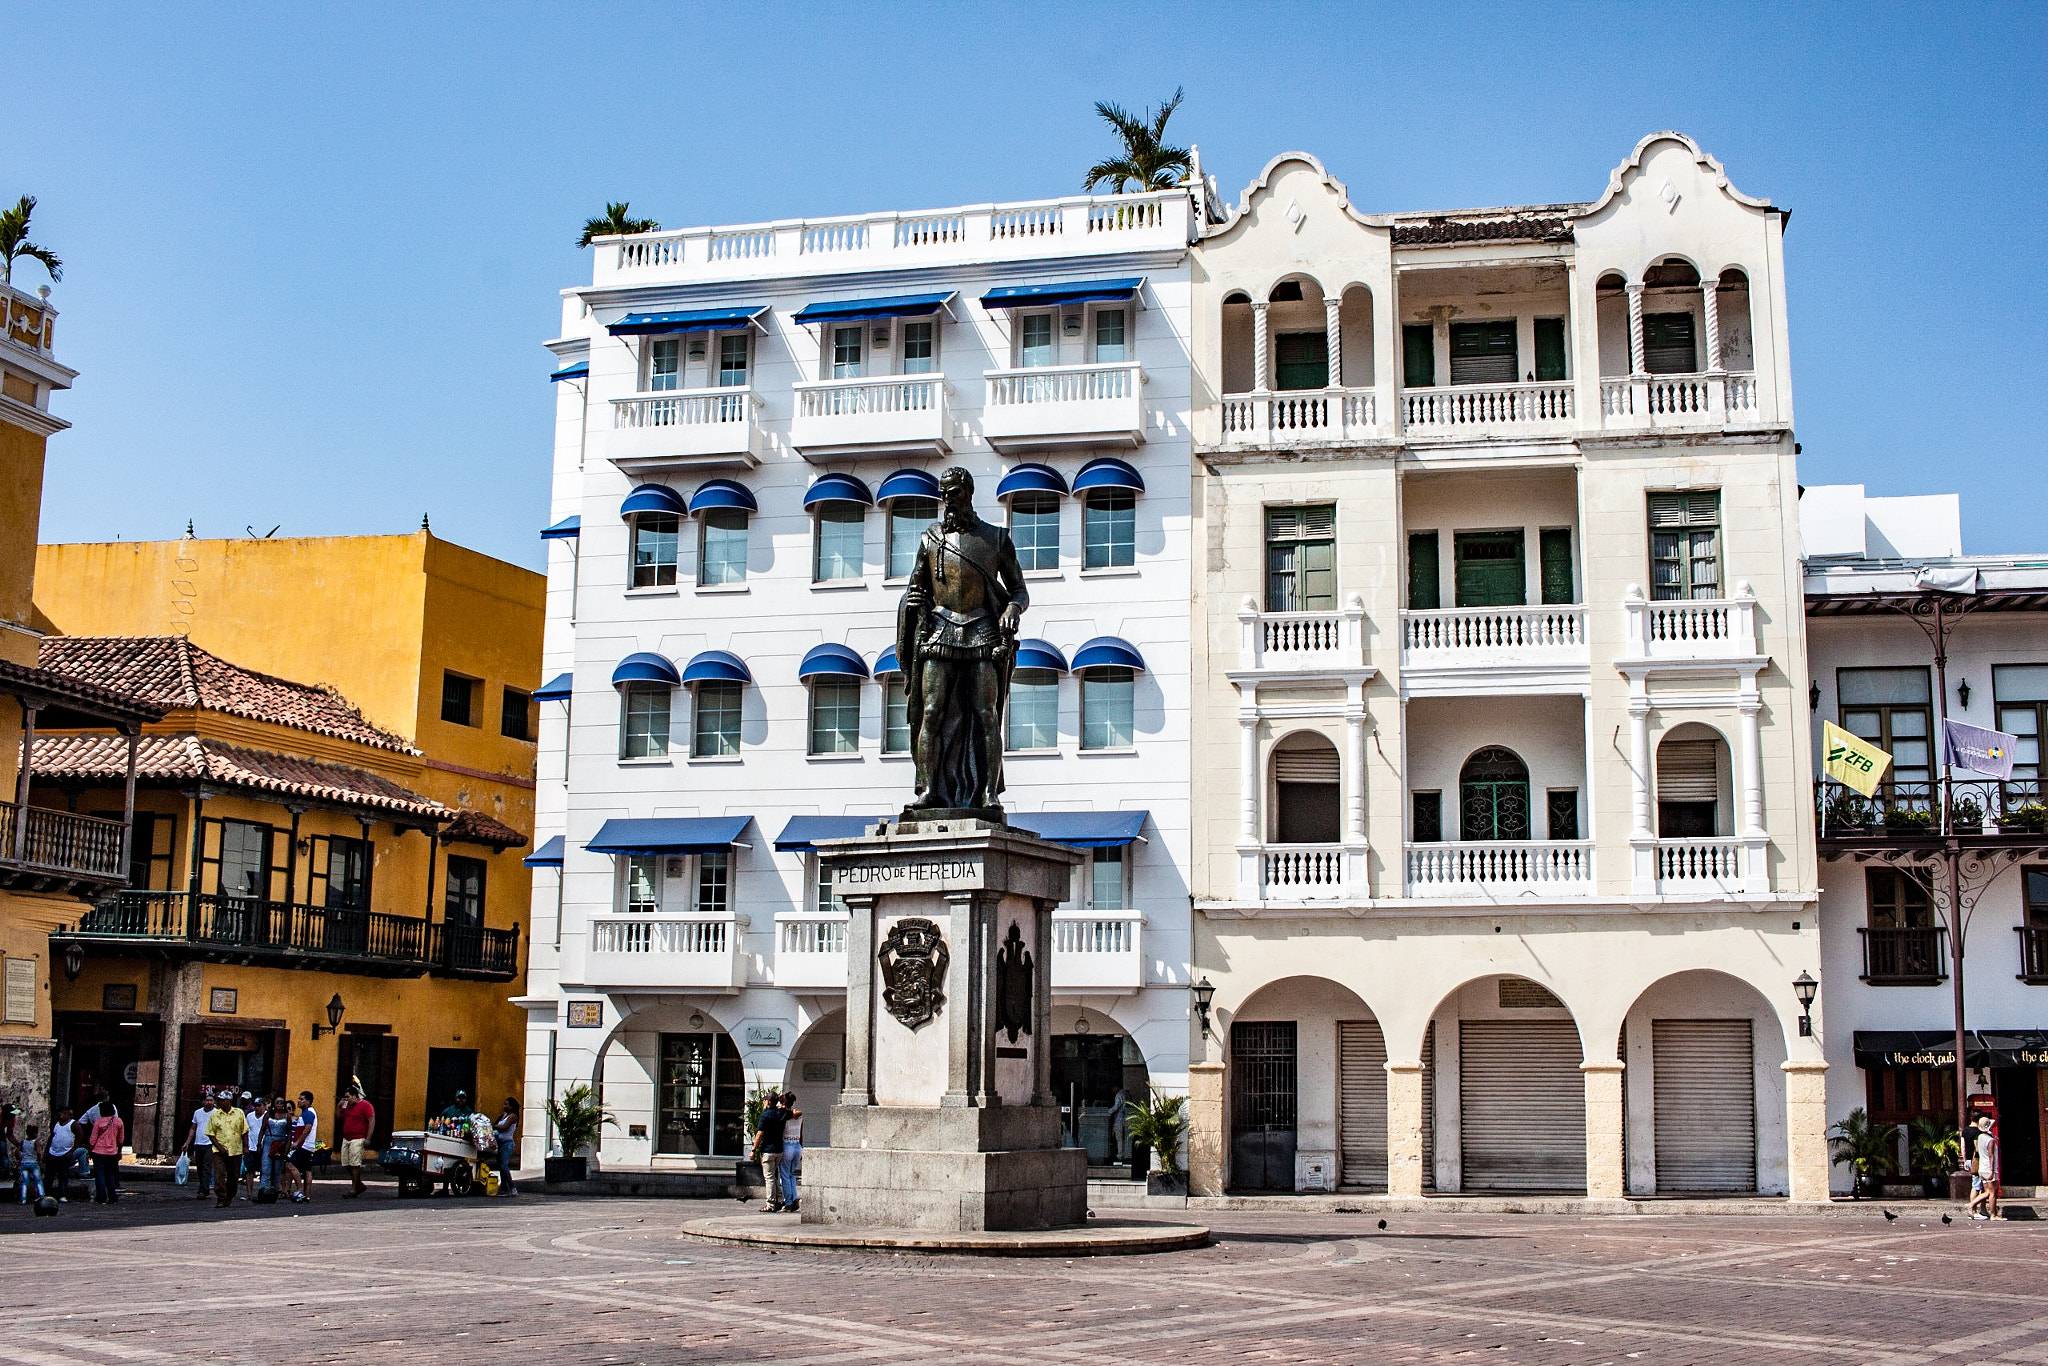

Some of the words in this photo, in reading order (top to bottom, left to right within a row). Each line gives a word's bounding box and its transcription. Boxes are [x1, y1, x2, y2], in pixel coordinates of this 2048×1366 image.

[1844, 750, 1873, 773] ZFB
[838, 864, 892, 883] PEDRO
[894, 867, 906, 878] DE
[908, 860, 976, 881] HEREDIA
[1893, 1052, 1910, 1066] the
[1911, 1051, 1938, 1067] clock
[1937, 1051, 1956, 1066] pub
[2021, 1050, 2038, 1065] the
